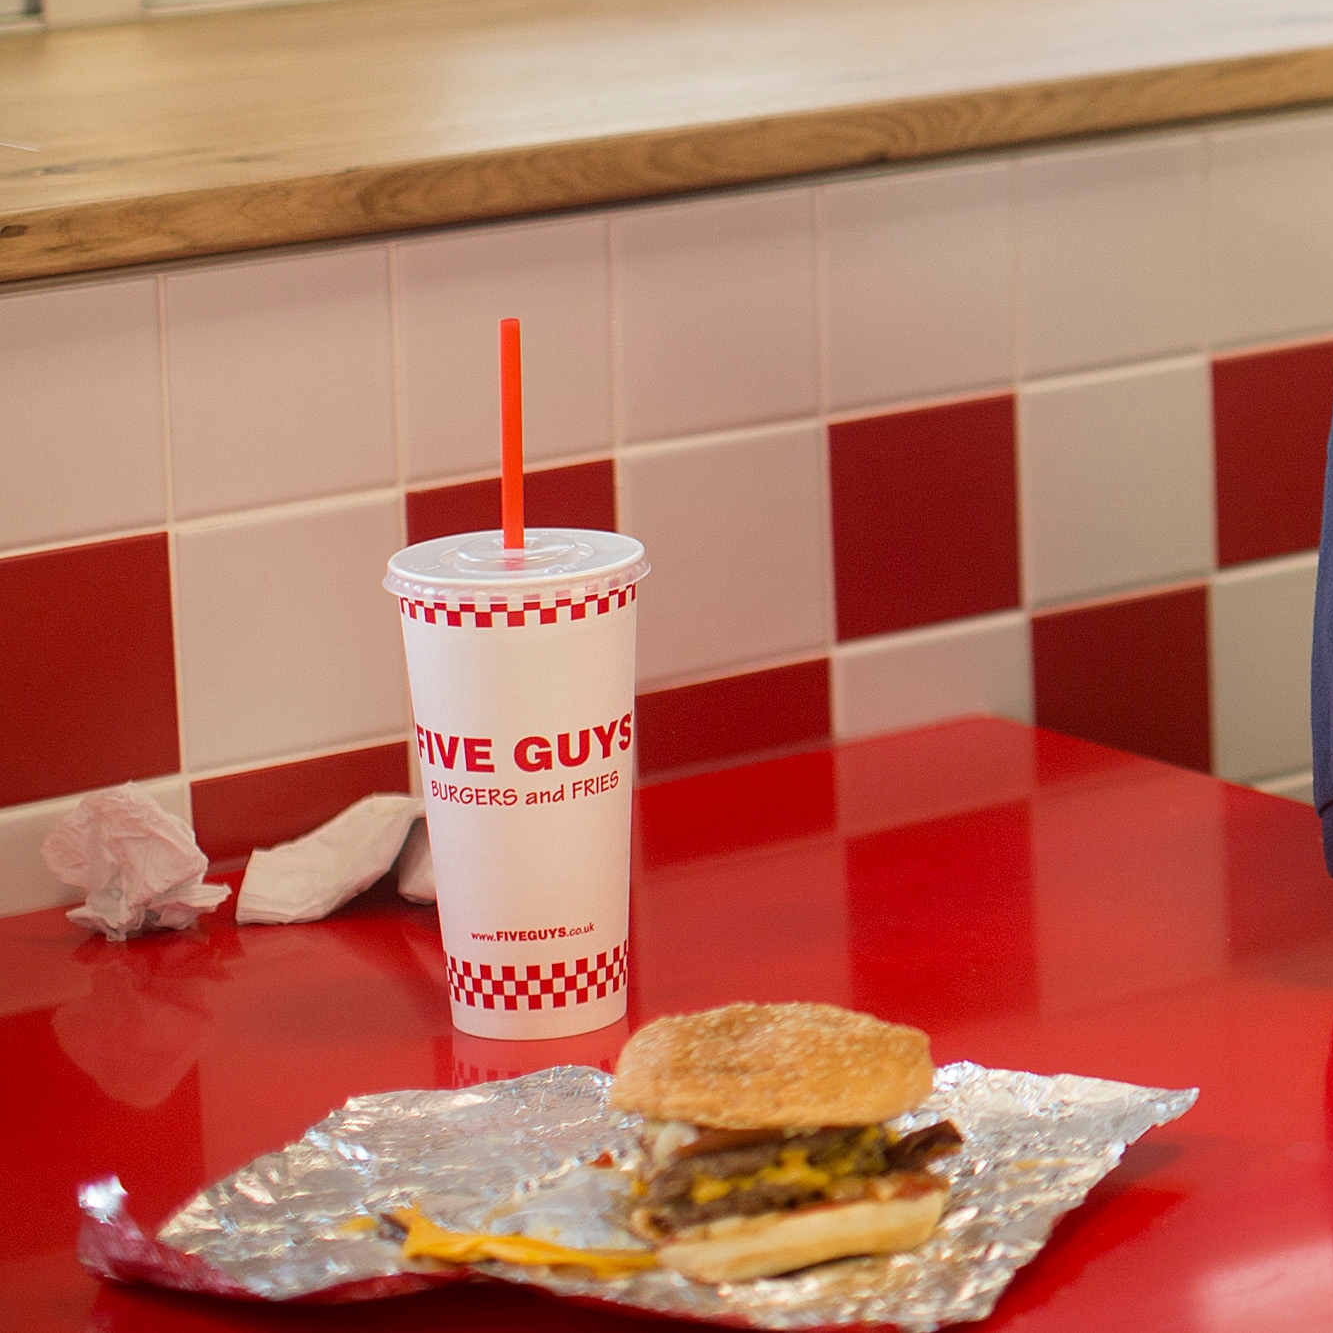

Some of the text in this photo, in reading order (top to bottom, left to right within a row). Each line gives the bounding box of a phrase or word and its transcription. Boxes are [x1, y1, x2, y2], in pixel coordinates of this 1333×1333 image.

[416, 713, 632, 774] FIVE GUYS
[431, 770, 620, 807] BURGERS and FRIES
[470, 921, 595, 942] www.FIVEGUYS.co.uk
